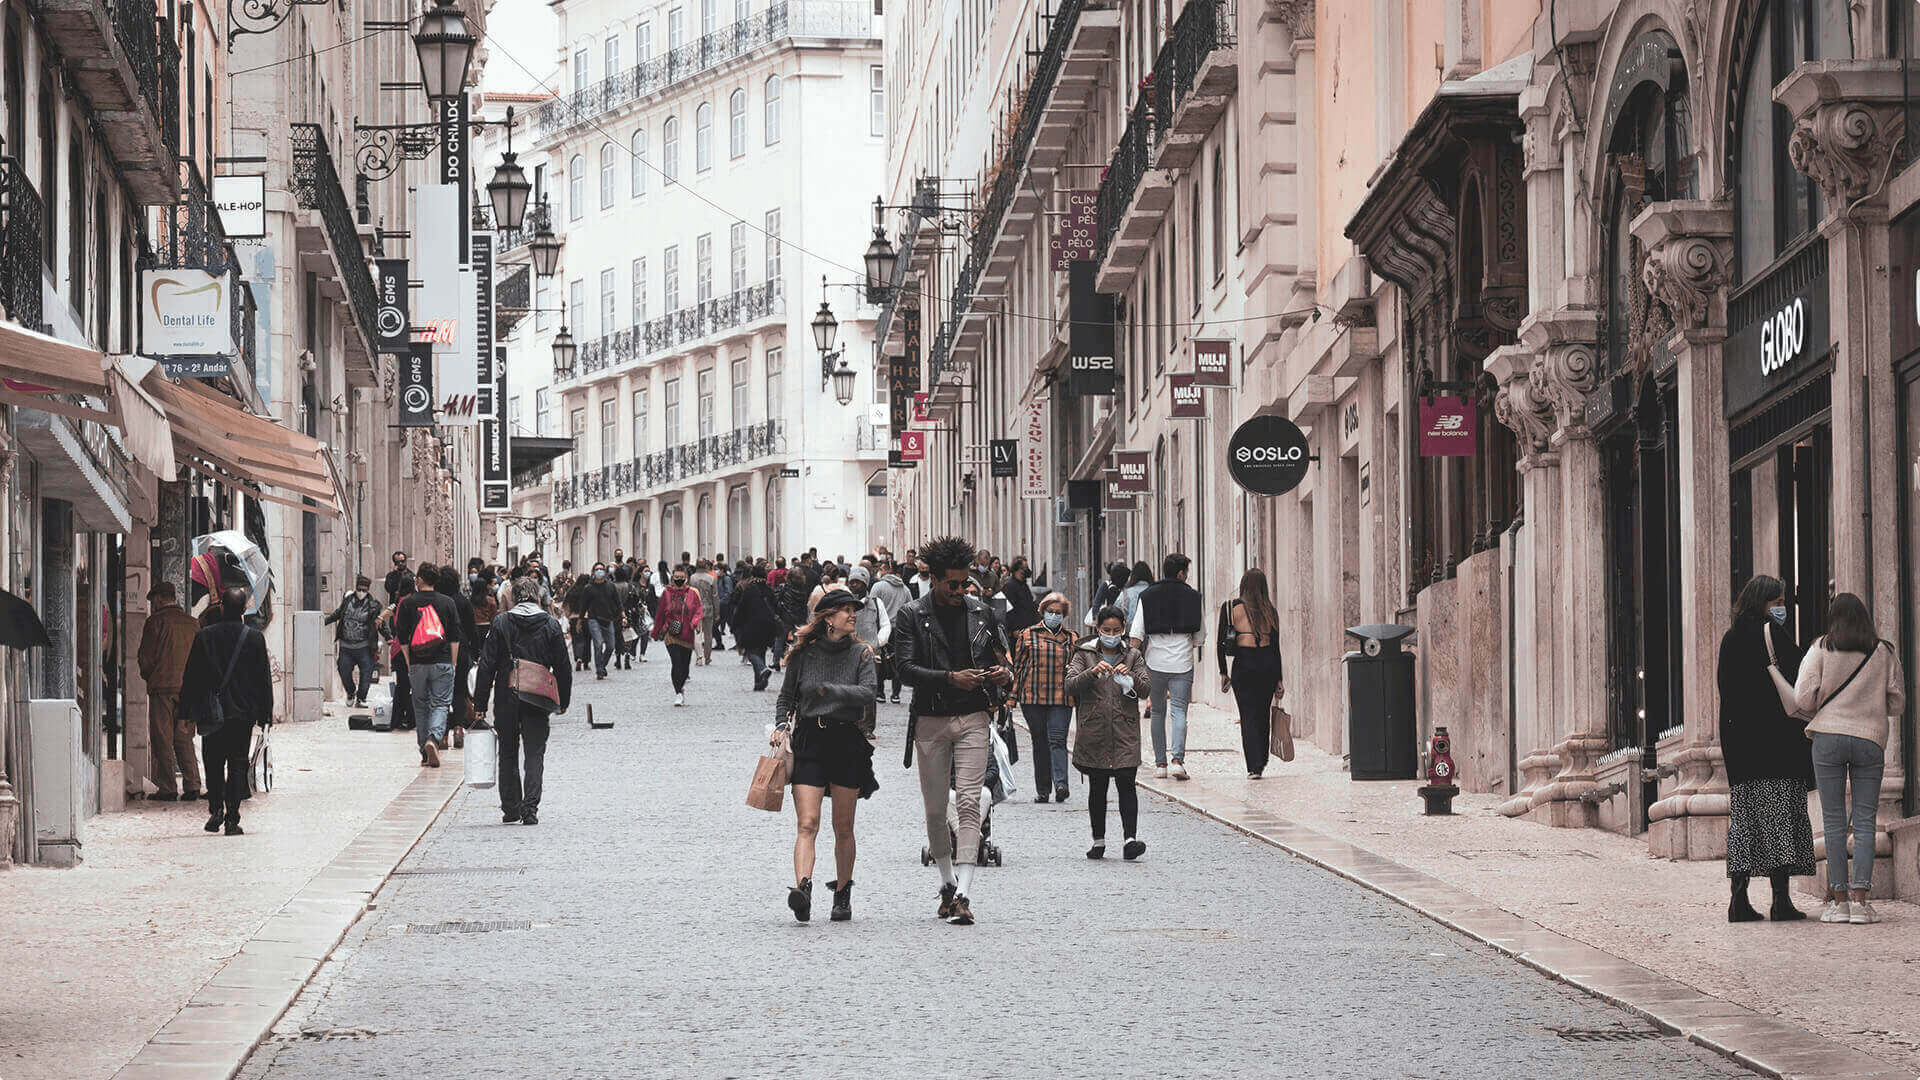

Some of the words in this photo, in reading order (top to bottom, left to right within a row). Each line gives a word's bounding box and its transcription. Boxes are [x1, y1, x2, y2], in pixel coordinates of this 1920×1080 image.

[447, 155, 459, 178] DO
[217, 202, 262, 211] ALE-HOP
[1073, 229, 1089, 238] DO
[1068, 238, 1094, 248] PÊLO
[1063, 250, 1078, 259] DO
[385, 275, 396, 305] GMS
[163, 314, 195, 326] Dental
[197, 314, 216, 326] Life
[1761, 297, 1804, 377] GLOBO
[907, 319, 920, 378] HAIR
[1198, 353, 1227, 366] MUJI
[172, 363, 183, 373] 76
[202, 363, 228, 373] Andar
[411, 356, 422, 383] GMS
[893, 365, 905, 421] HAIR
[1174, 386, 1201, 399] MUJI
[1252, 446, 1302, 461] OSLO
[1120, 463, 1145, 475] MUJI
